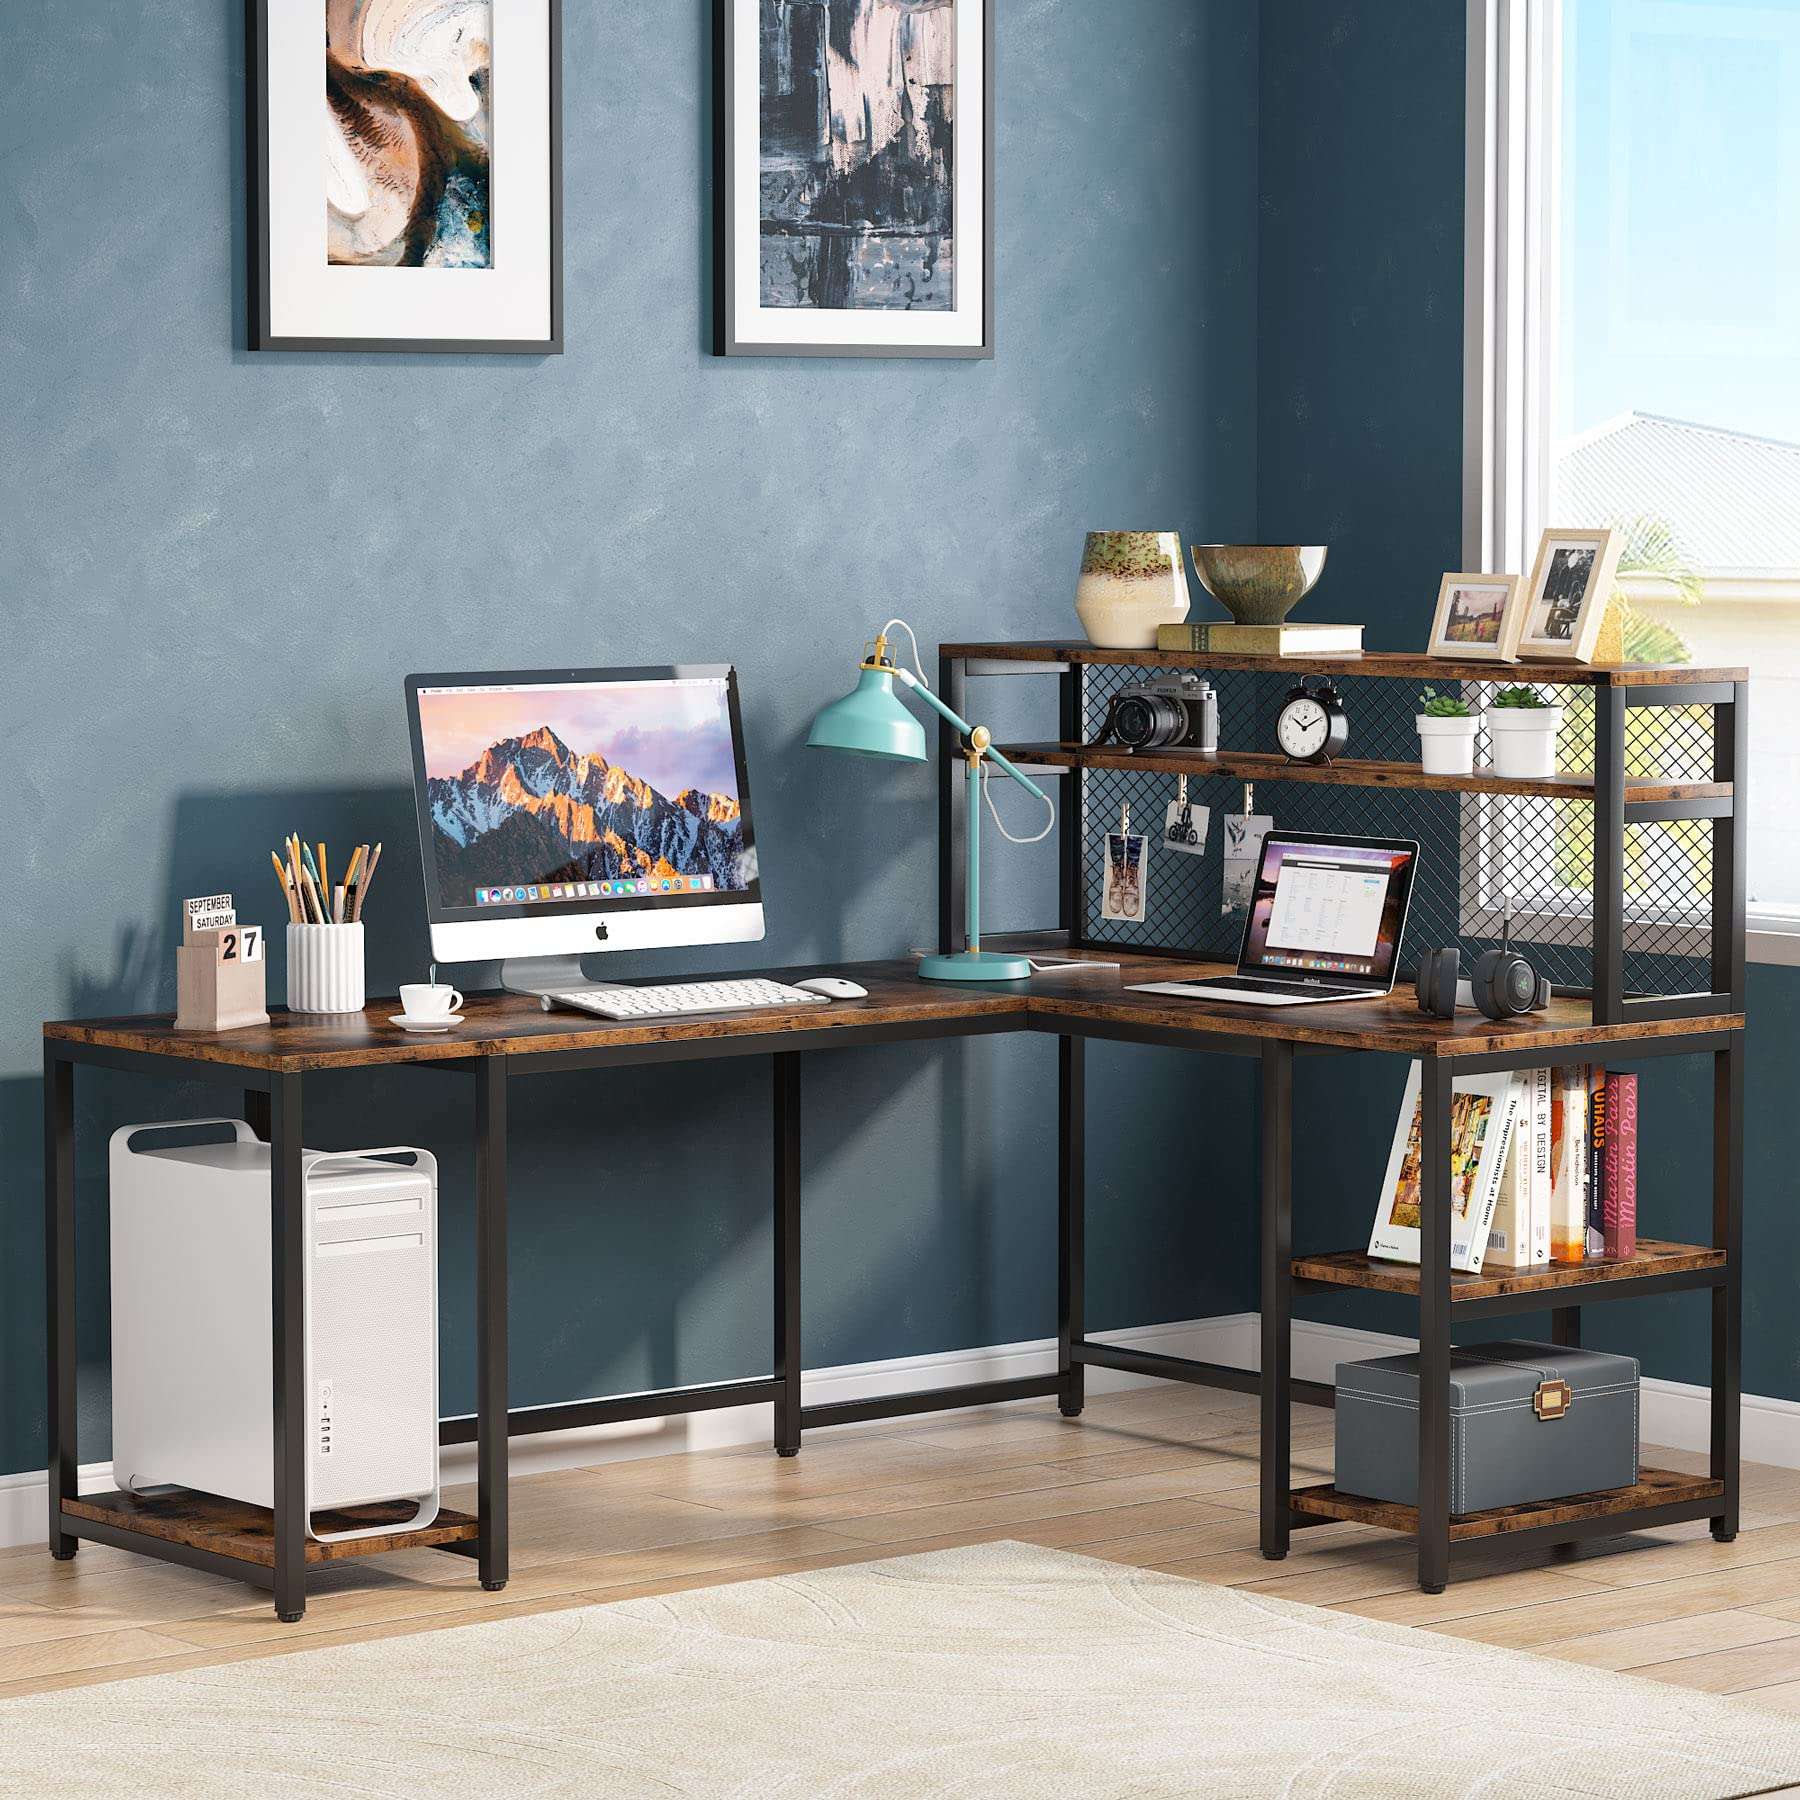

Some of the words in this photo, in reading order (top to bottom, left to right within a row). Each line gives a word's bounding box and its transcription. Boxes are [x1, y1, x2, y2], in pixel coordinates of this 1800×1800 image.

[189, 896, 231, 914] SEPTEMBER
[196, 914, 234, 929] SATURDAY
[1537, 1069, 1547, 1106] IGITAL
[1509, 1100, 1517, 1116] The
[1537, 1113, 1547, 1126] BY
[1604, 1078, 1618, 1136] Parr
[1620, 1078, 1636, 1136] Parr
[1492, 1118, 1513, 1185] Impressionists
[1536, 1133, 1546, 1174] DESIGN
[1488, 1187, 1495, 1197] at
[1604, 1142, 1618, 1228] Martin
[1619, 1141, 1635, 1229] Martin
[1482, 1200, 1493, 1226] Home
